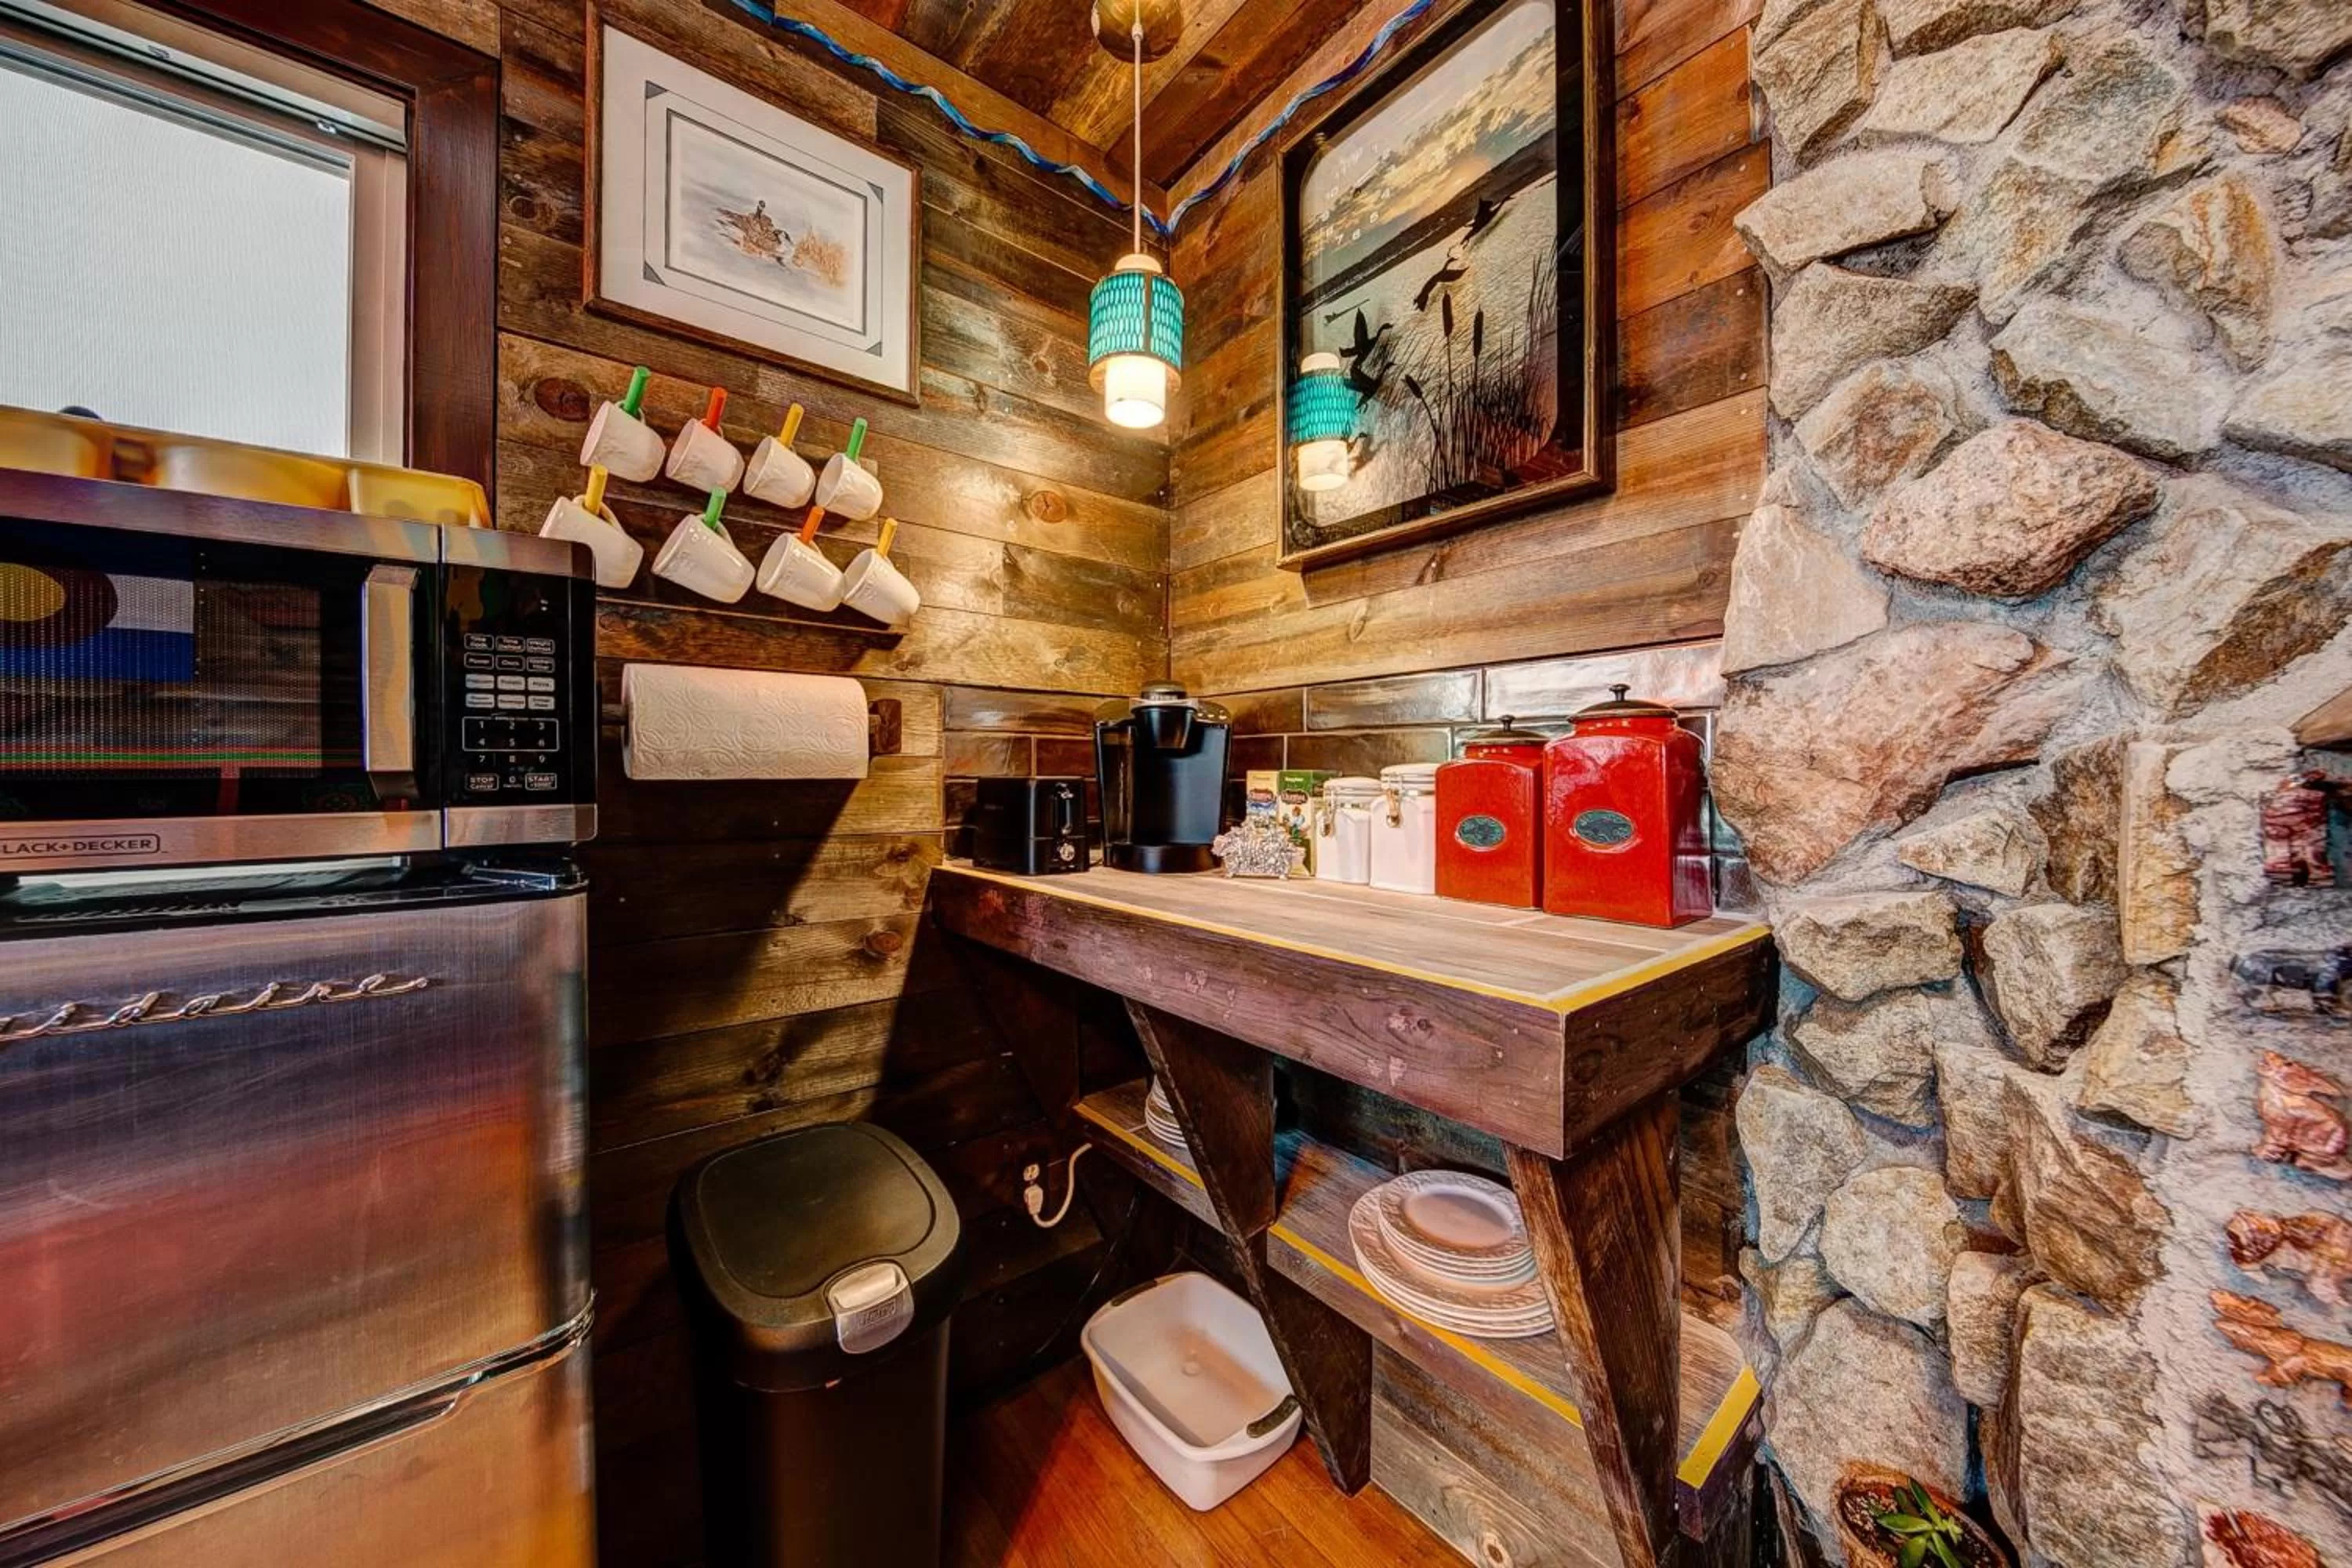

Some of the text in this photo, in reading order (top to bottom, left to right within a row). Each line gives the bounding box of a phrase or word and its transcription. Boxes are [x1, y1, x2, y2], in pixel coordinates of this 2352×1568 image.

[509, 721, 515, 730] 2
[539, 722, 545, 731] 3
[478, 738, 485, 746] 4
[509, 738, 515, 747] 5
[479, 754, 486, 763] 7
[509, 755, 516, 764] 8
[539, 754, 546, 764] 9
[509, 775, 516, 784] 0
[0, 839, 151, 854] LACK+DECKER
